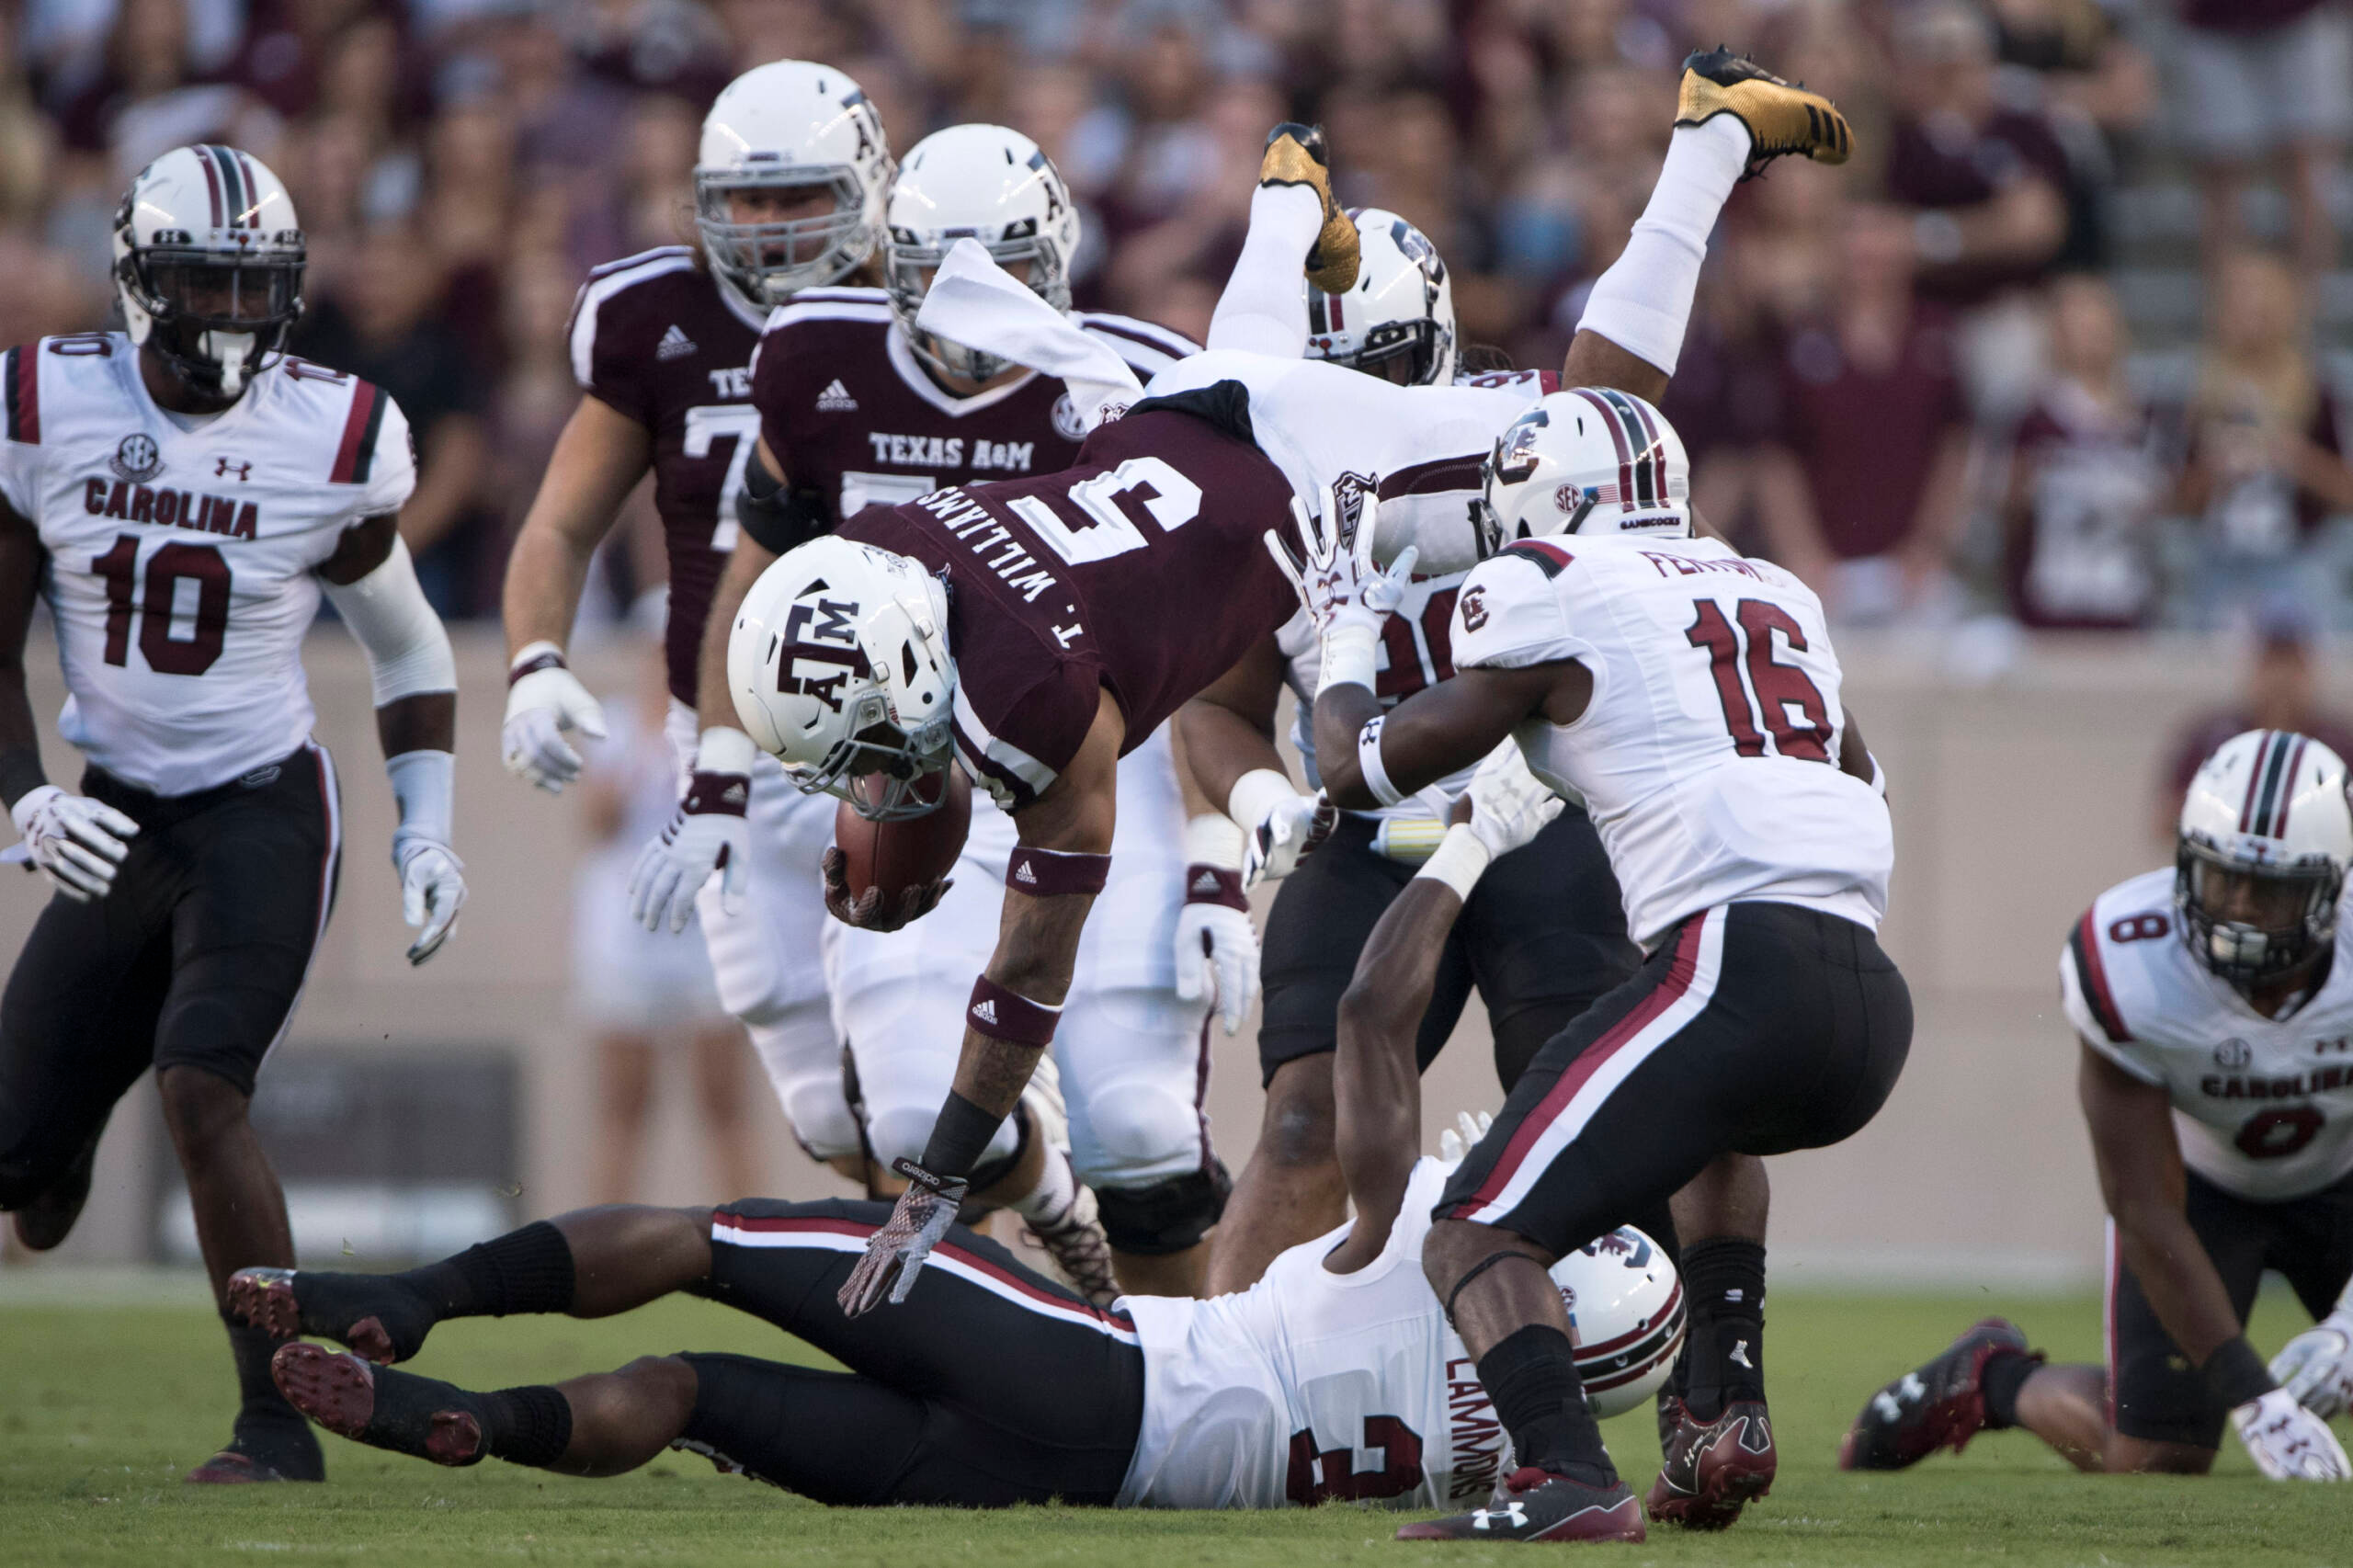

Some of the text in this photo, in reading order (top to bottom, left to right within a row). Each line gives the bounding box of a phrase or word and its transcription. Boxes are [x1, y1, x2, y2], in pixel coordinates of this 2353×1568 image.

[708, 367, 753, 399] TE
[683, 403, 763, 551] 7
[869, 431, 1035, 471] TEXAS A&M
[85, 475, 259, 540] CAROLINA
[1006, 456, 1203, 566] 5
[1555, 483, 1582, 513] SEC
[1620, 517, 1680, 530] GAMECOCKS
[915, 485, 1057, 603] WILLIAMS
[90, 533, 232, 676] 10
[1683, 597, 1834, 765] 16
[1015, 872, 1037, 884] adidas
[971, 1006, 998, 1026] adidas
[902, 1162, 941, 1186] adizero
[1446, 1357, 1501, 1500] LAMMONS
